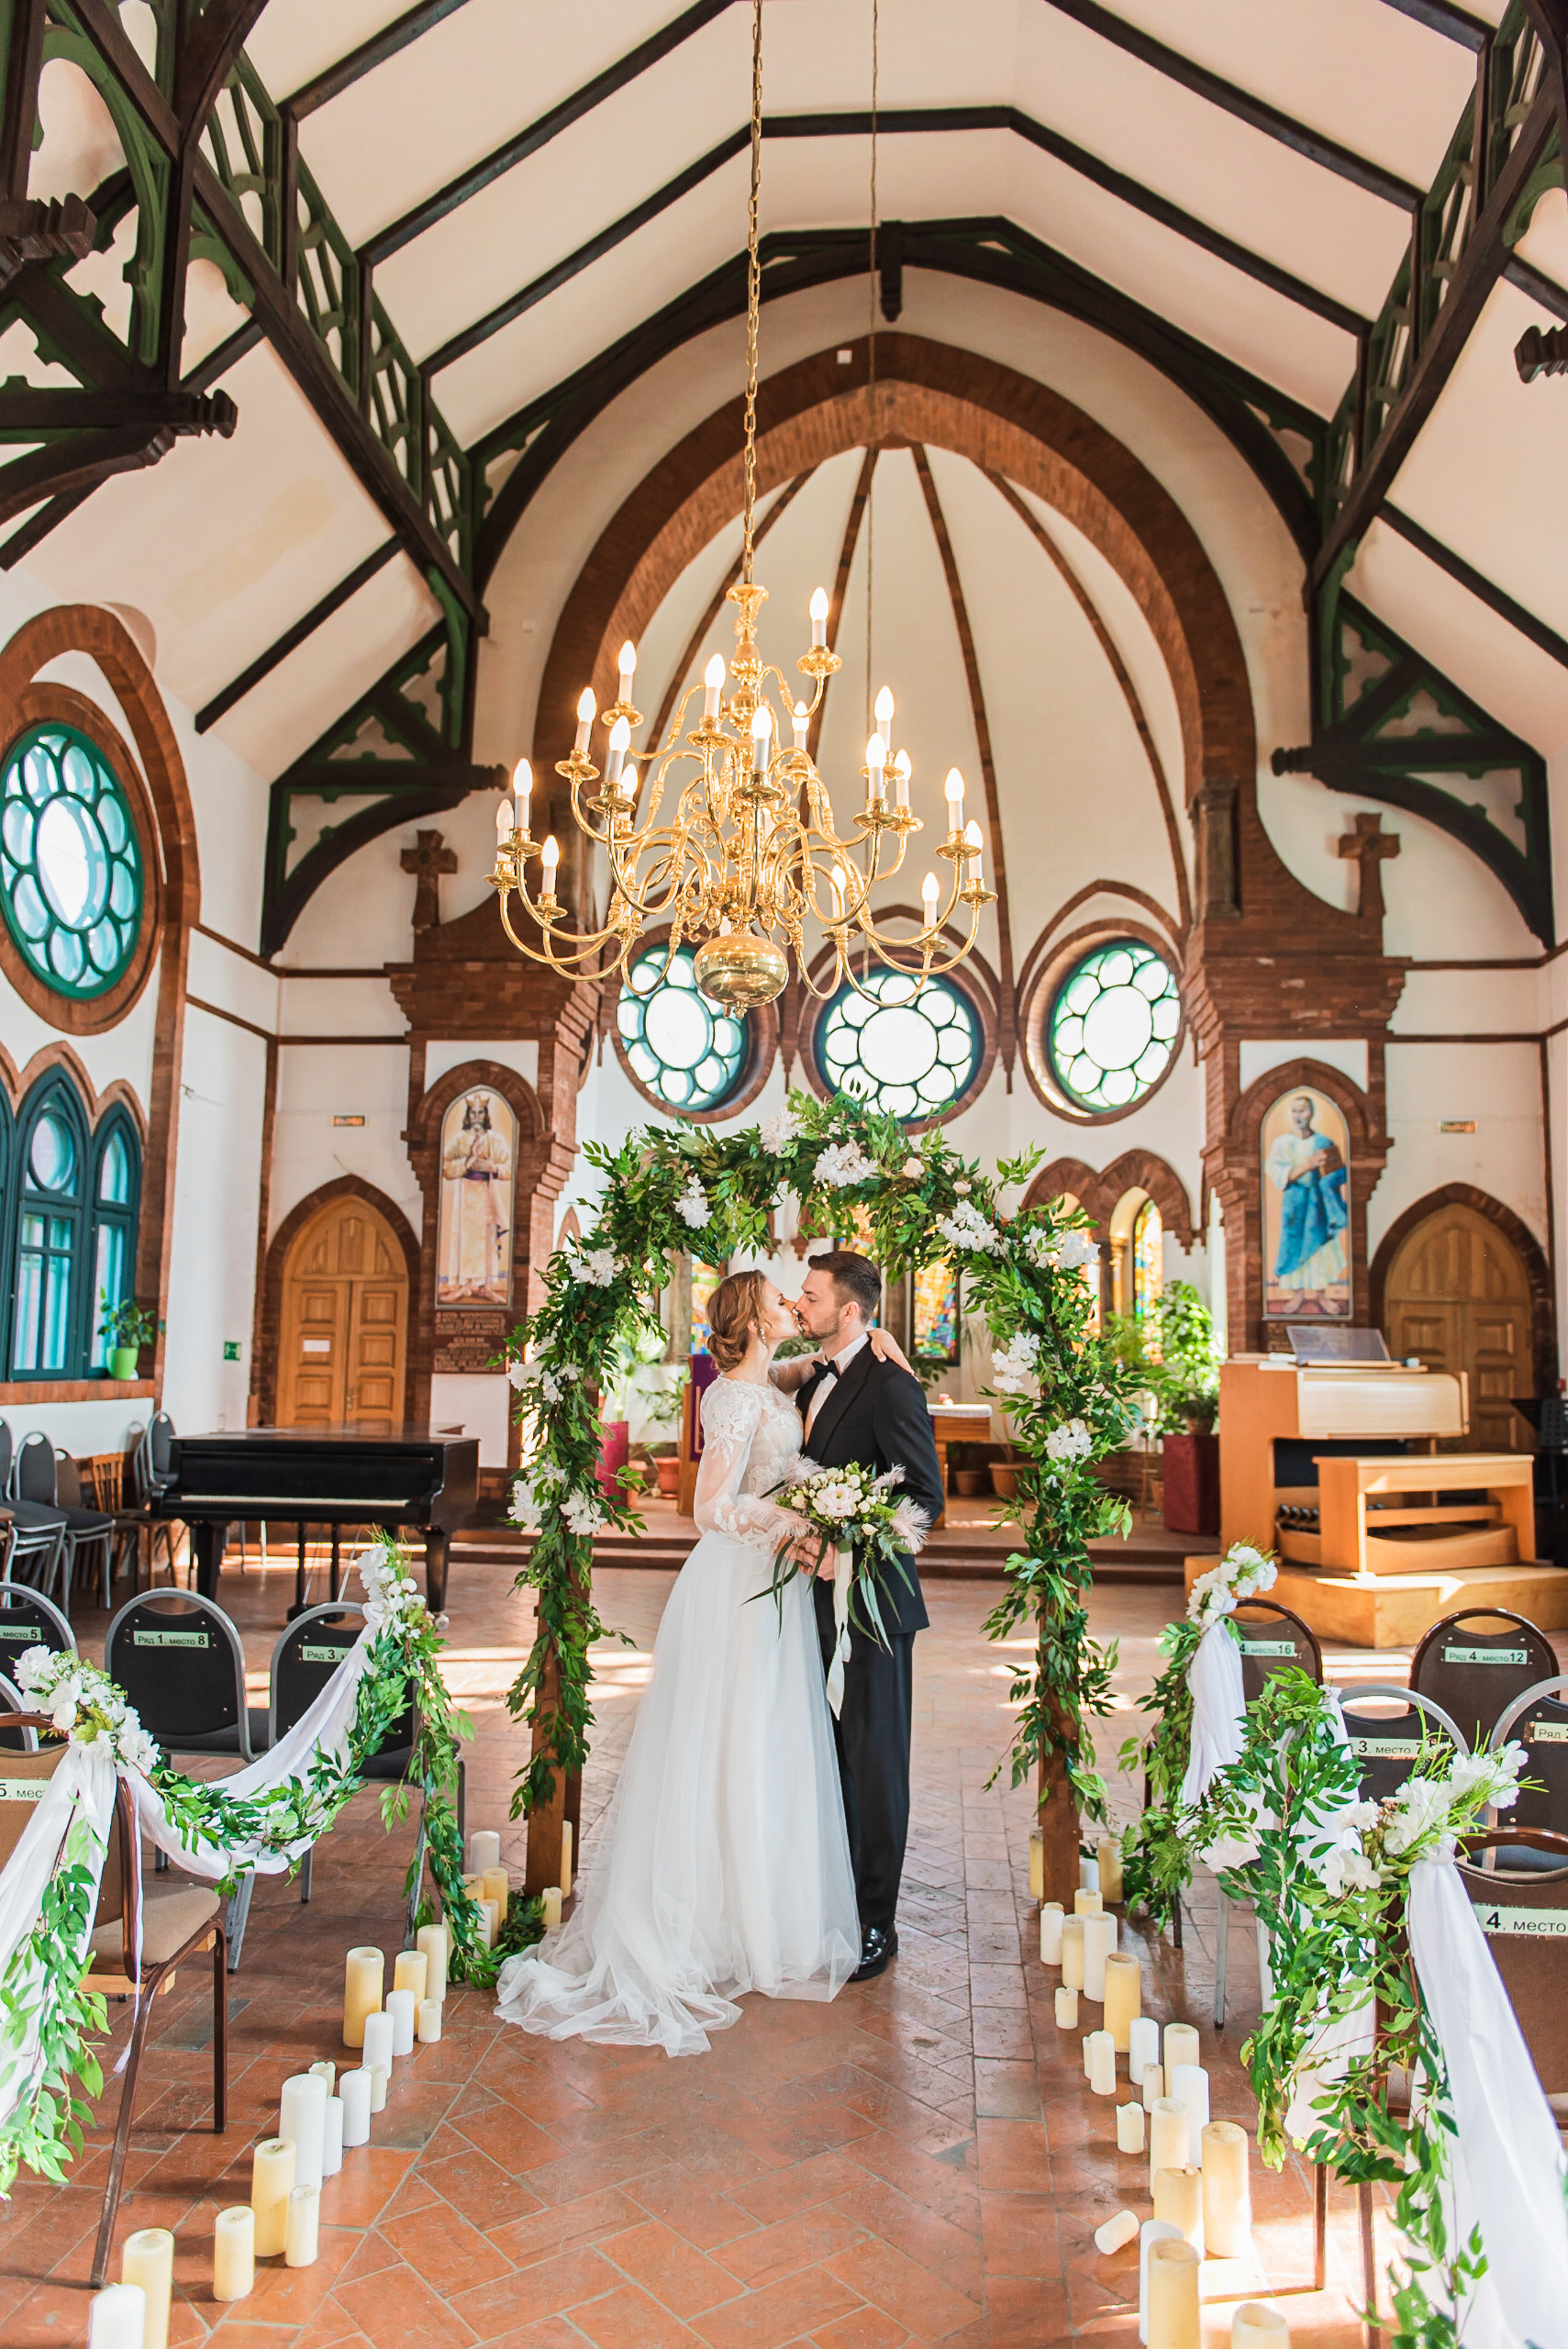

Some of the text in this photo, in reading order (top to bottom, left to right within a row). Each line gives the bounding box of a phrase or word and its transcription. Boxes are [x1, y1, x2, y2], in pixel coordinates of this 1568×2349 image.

[31, 1629, 38, 1638] 5
[138, 1635, 154, 1644] Ряд
[198, 1635, 205, 1645] 8
[1278, 1644, 1292, 1654] 16
[307, 1650, 325, 1660] Ряд
[1449, 1652, 1467, 1661] Ряд
[1510, 1653, 1524, 1662] 12
[1539, 1728, 1561, 1740] Ряд
[1376, 1746, 1411, 1755] место
[17, 1789, 46, 1798] мес
[1513, 1921, 1566, 1933] место
